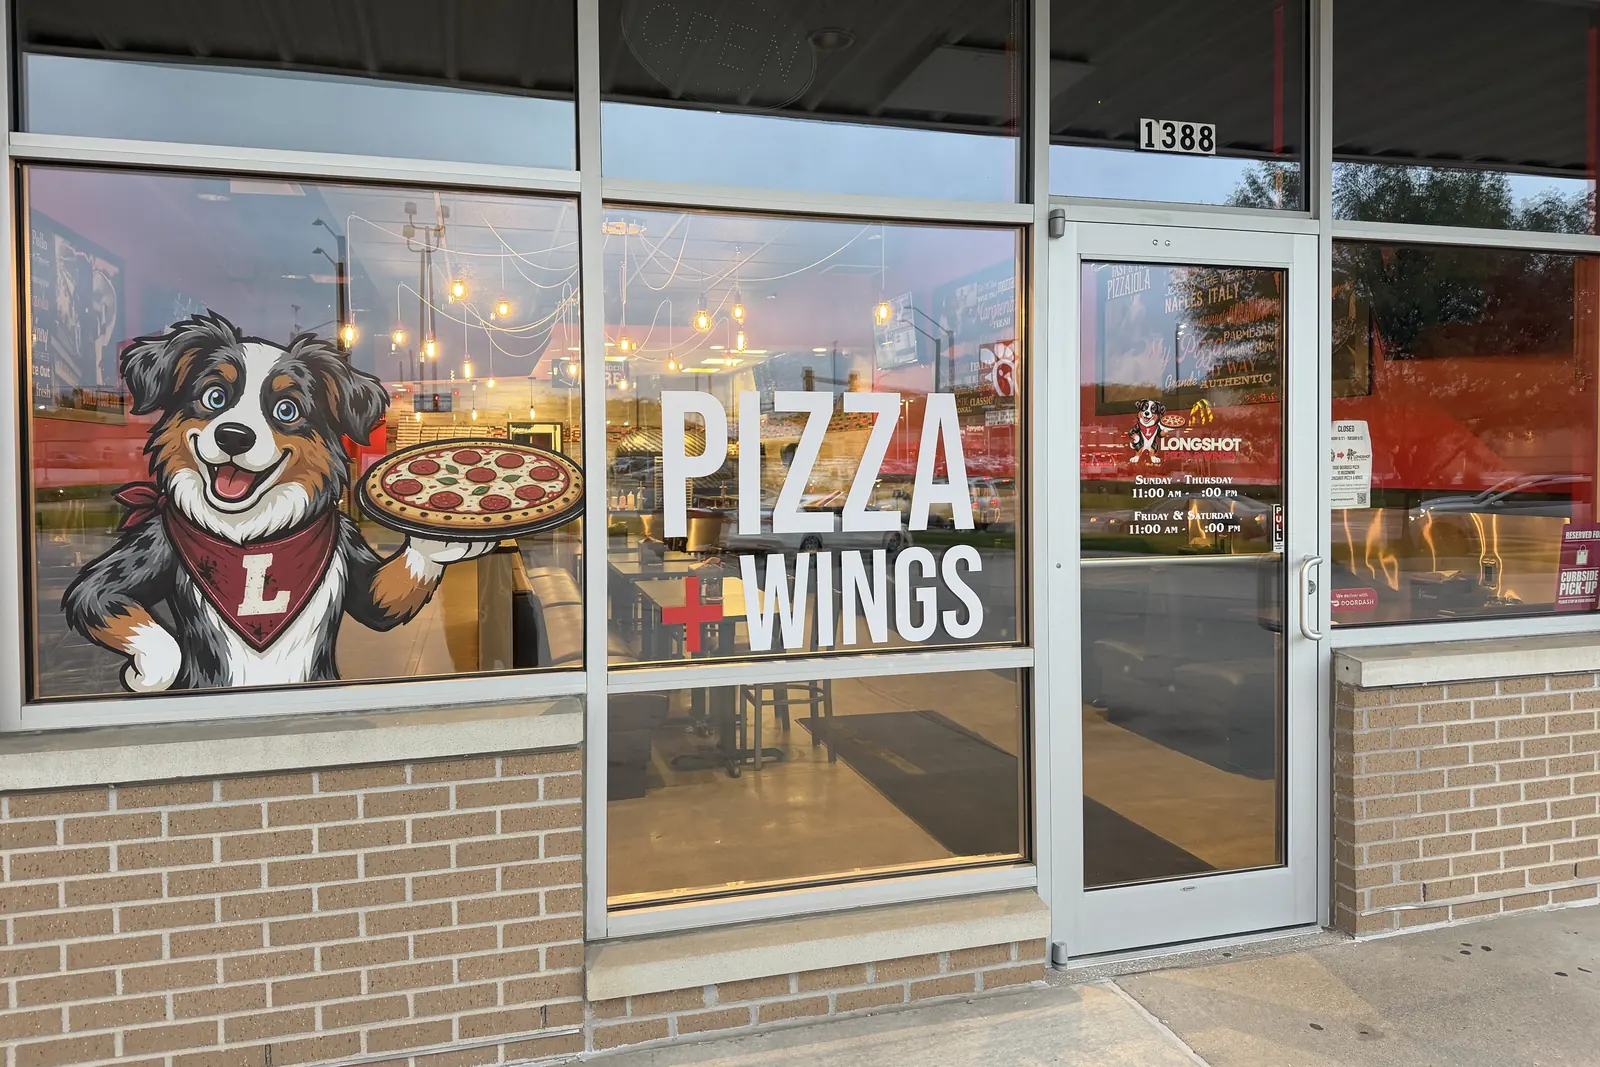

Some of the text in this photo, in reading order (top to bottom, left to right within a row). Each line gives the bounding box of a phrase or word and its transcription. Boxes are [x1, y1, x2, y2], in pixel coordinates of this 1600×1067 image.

[1144, 121, 1214, 153] 1388
[1107, 269, 1151, 301] PIZZAIOLA
[1207, 282, 1240, 304] ITALY
[1227, 357, 1257, 375] WAY
[36, 381, 51, 399] fresh
[1200, 373, 1272, 390] AUTHENTIC
[1337, 425, 1355, 433] CLOSED
[1160, 437, 1242, 452] LONGSHOT
[661, 390, 975, 539] PIZZA
[1135, 475, 1173, 485] SUNDAY
[1184, 475, 1233, 485] THURSDAY
[1132, 488, 1165, 498] 11:00
[1167, 490, 1182, 498] AM
[1225, 489, 1238, 498] PM
[1134, 510, 1234, 521] FRIDAY & SATURDAY
[1275, 506, 1283, 541] PULL
[1129, 524, 1161, 535] 11:00
[1164, 526, 1178, 534] AM
[1227, 524, 1241, 533] PM
[1565, 530, 1593, 540] RESERVED
[237, 553, 290, 616] L
[1560, 570, 1599, 583] CURBSIDE
[1559, 581, 1598, 596] PICK-UP
[739, 543, 984, 652] WINGS
